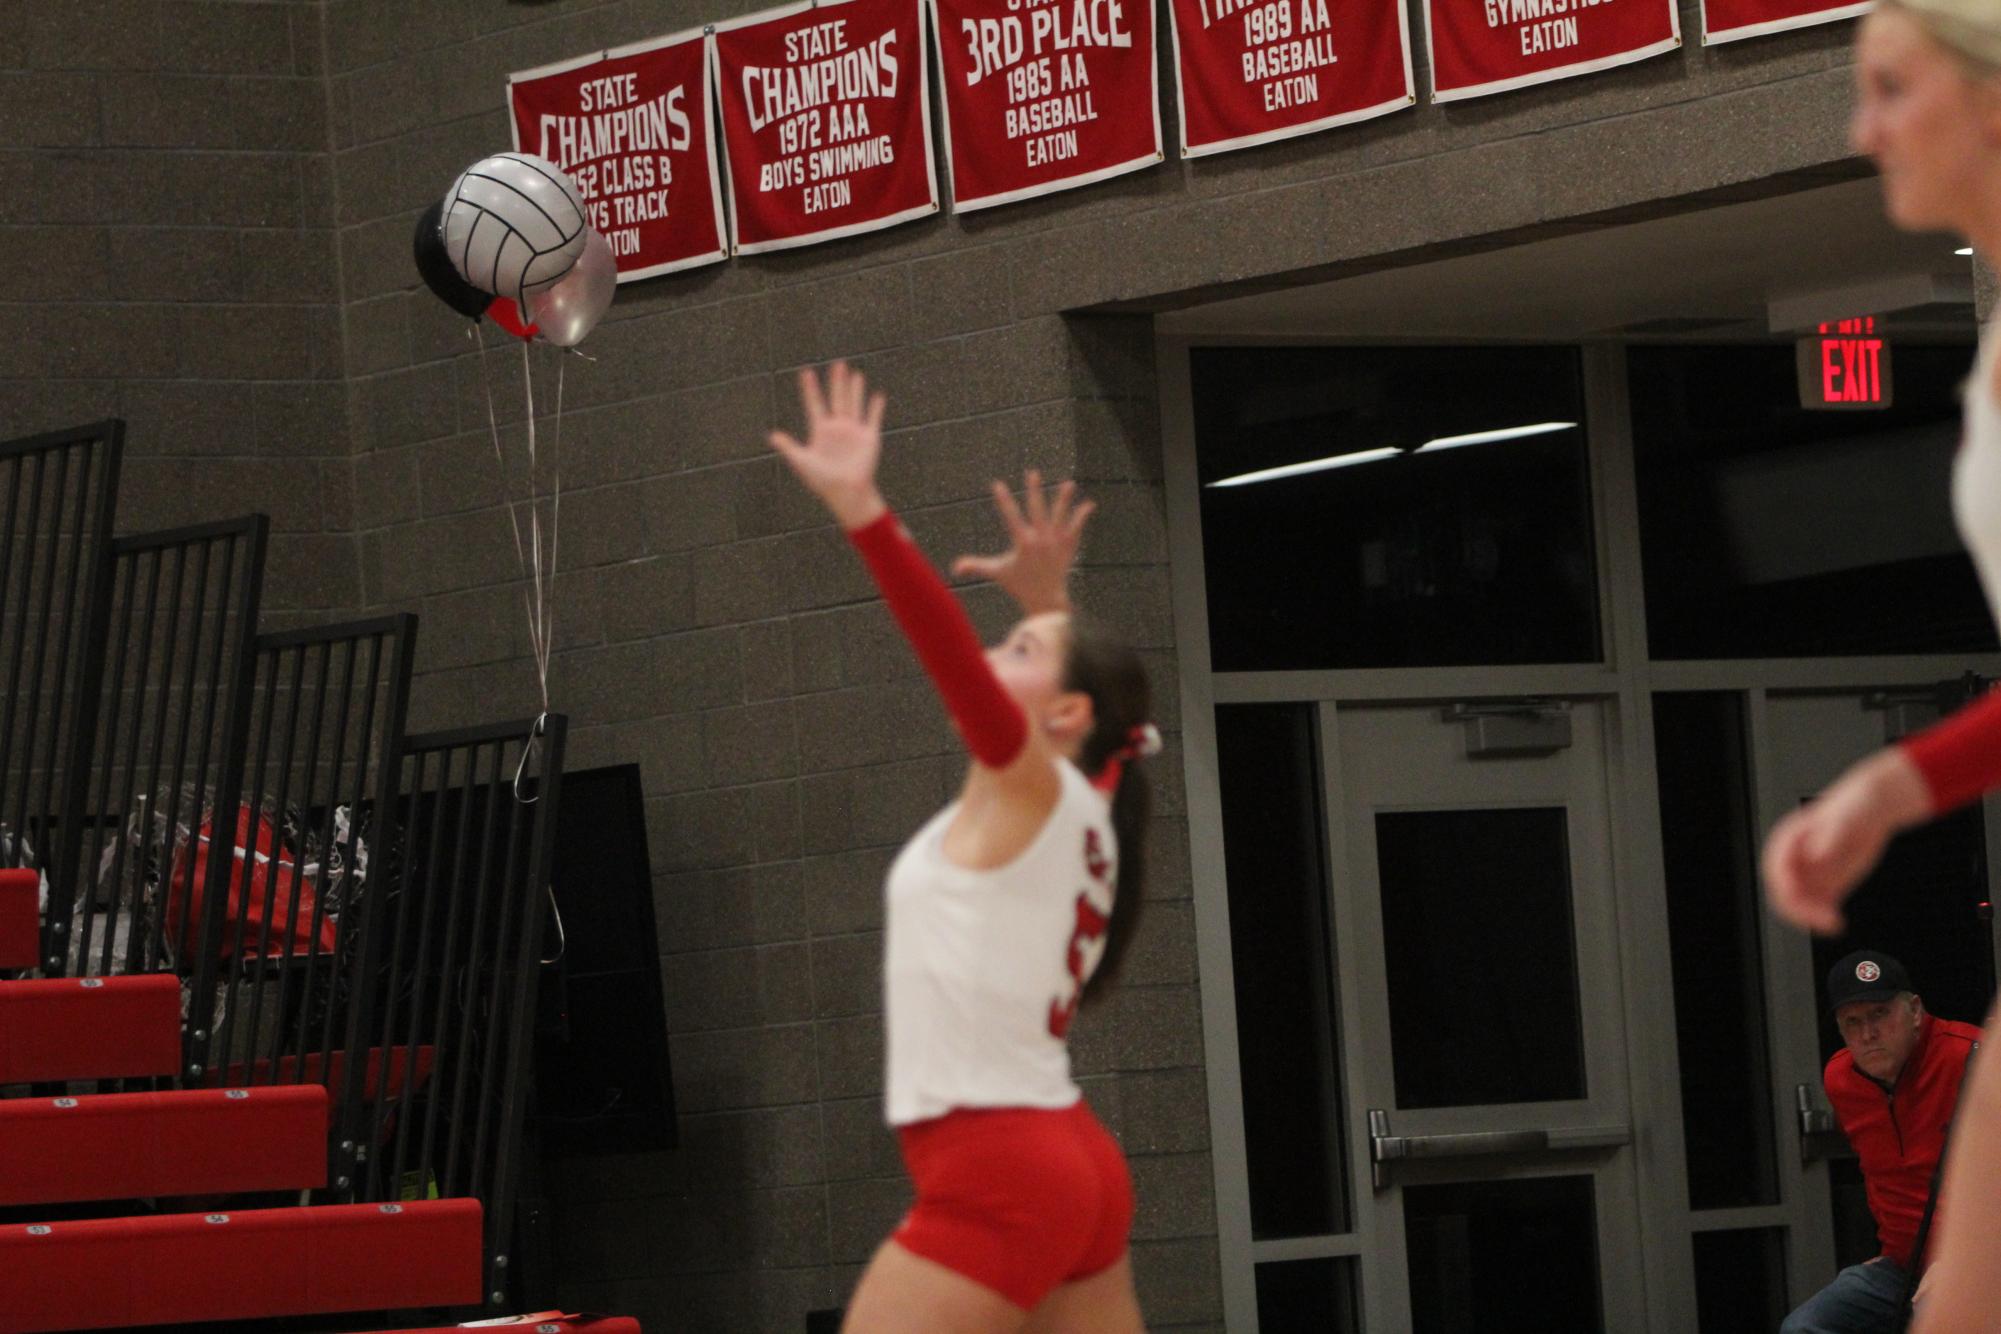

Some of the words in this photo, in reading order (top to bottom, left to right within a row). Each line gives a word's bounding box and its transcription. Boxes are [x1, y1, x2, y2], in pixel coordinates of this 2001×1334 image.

[784, 19, 848, 63] STATE
[962, 15, 1024, 87] 3RD
[1031, 0, 1132, 55] PLACE
[1244, 0, 1293, 47] 1989
[1301, 0, 1331, 34] AA
[1520, 16, 1579, 56] EATON
[742, 28, 898, 134] CHAMPIONS
[1006, 57, 1052, 104] 1985
[1060, 53, 1089, 92] AA
[1242, 34, 1338, 83] BASEBALL
[580, 73, 639, 112] STATE
[1005, 91, 1098, 139] BASEBALL
[1263, 74, 1318, 112] EATON
[540, 84, 691, 170] CHAMPIONS
[779, 109, 821, 155] 1972
[829, 103, 870, 144] AAA
[1026, 130, 1078, 167] EATON
[602, 156, 654, 195] CLASS
[660, 156, 672, 185] B
[759, 156, 804, 192] BOYS
[809, 135, 894, 181] SWIMMING
[614, 190, 668, 225] TRACK
[803, 180, 850, 215] EATON
[1821, 339, 1882, 403] EXIT
